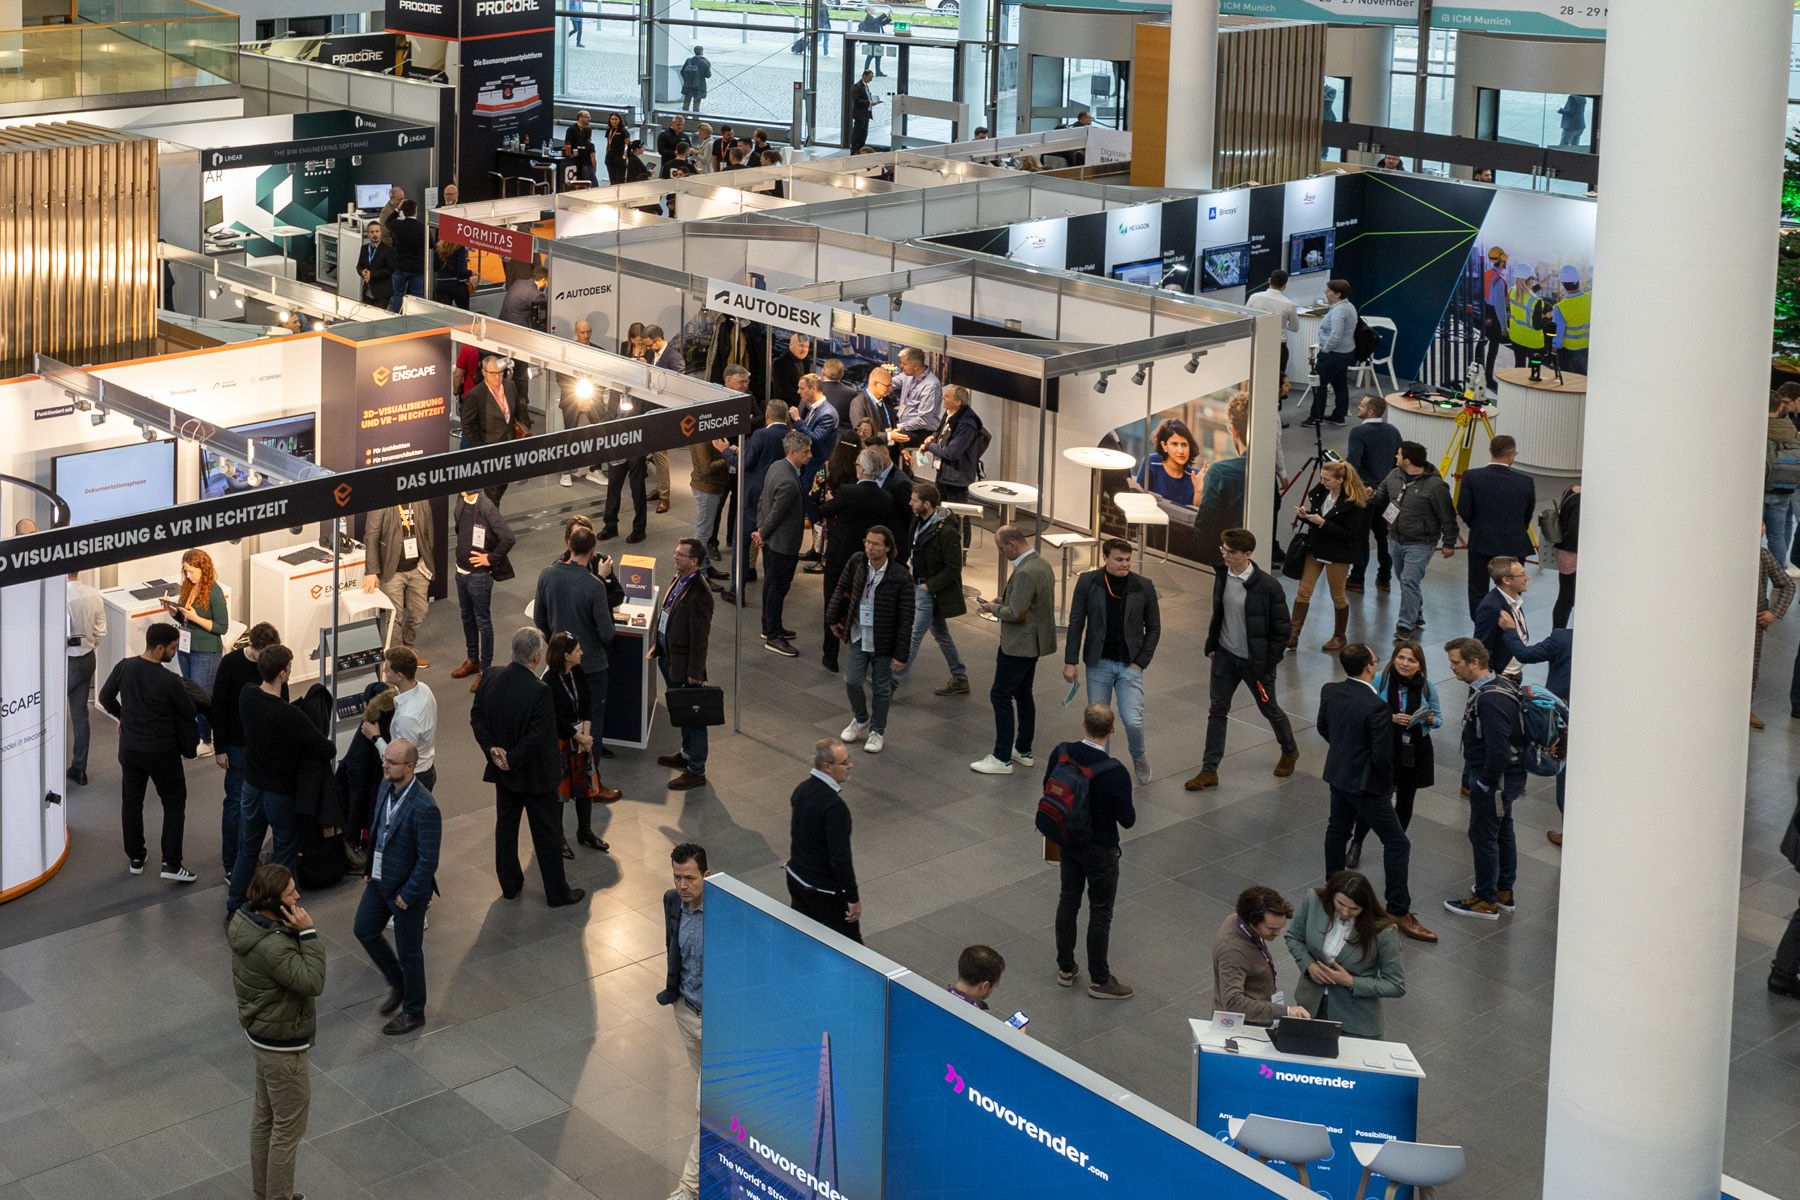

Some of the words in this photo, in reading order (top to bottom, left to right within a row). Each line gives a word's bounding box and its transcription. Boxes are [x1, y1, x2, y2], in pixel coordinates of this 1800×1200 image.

[400, 0, 443, 14] PROCORE
[1223, 2, 1241, 11] ICM
[1242, 2, 1276, 12] Munich
[1560, 6, 1574, 16] 28
[1586, 7, 1600, 17] 29
[1452, 14, 1472, 24] ICM
[1474, 16, 1512, 26] Munich
[332, 51, 384, 64] PROCORE
[482, 52, 543, 66] Baumanagementplattform
[364, 120, 377, 128] LINEAR
[409, 134, 426, 142] LINEAR
[224, 154, 243, 162] LINEAR
[286, 148, 298, 156] BIM
[299, 144, 338, 154] ENGINEERING
[339, 140, 369, 150] SOFTWARE
[1100, 148, 1127, 158] Digitale
[1219, 206, 1237, 216] Bricsys
[1128, 222, 1150, 232] HEXAGON
[456, 223, 513, 248] FORMITAS
[1252, 234, 1266, 242] Bricsys
[566, 284, 612, 300] AUTODESK
[733, 293, 822, 328] AUTODESK
[392, 365, 436, 382] ENSCAPE
[37, 408, 64, 417] Funktioniert
[362, 397, 444, 419] 3D-VISUALISIERUNG
[361, 418, 380, 429] UND
[380, 416, 392, 426] VR
[398, 413, 407, 422] IN
[408, 406, 446, 420] ECHTZEIT
[397, 471, 427, 492] DAS
[429, 456, 512, 484] ULTIMATIVE
[515, 439, 592, 467] WORKFLOW
[596, 429, 643, 451] PLUGIN
[698, 414, 739, 432] ENSCAPE
[84, 478, 147, 495] Dokumentationsphase
[10, 527, 150, 570] VISUALISIERUNG
[153, 524, 167, 540] &
[170, 519, 192, 537] VR
[195, 514, 214, 532] IN
[215, 500, 288, 528] ECHTZEIT
[325, 580, 357, 593] ENCAPE
[24, 728, 48, 743] seconds
[1275, 1071, 1356, 1089] novorender
[968, 1087, 1109, 1181] novorender.com
[1355, 1129, 1397, 1141] Possibilities
[718, 1153, 734, 1169] The
[735, 1164, 766, 1192] World's
[750, 1136, 848, 1200] novorender
